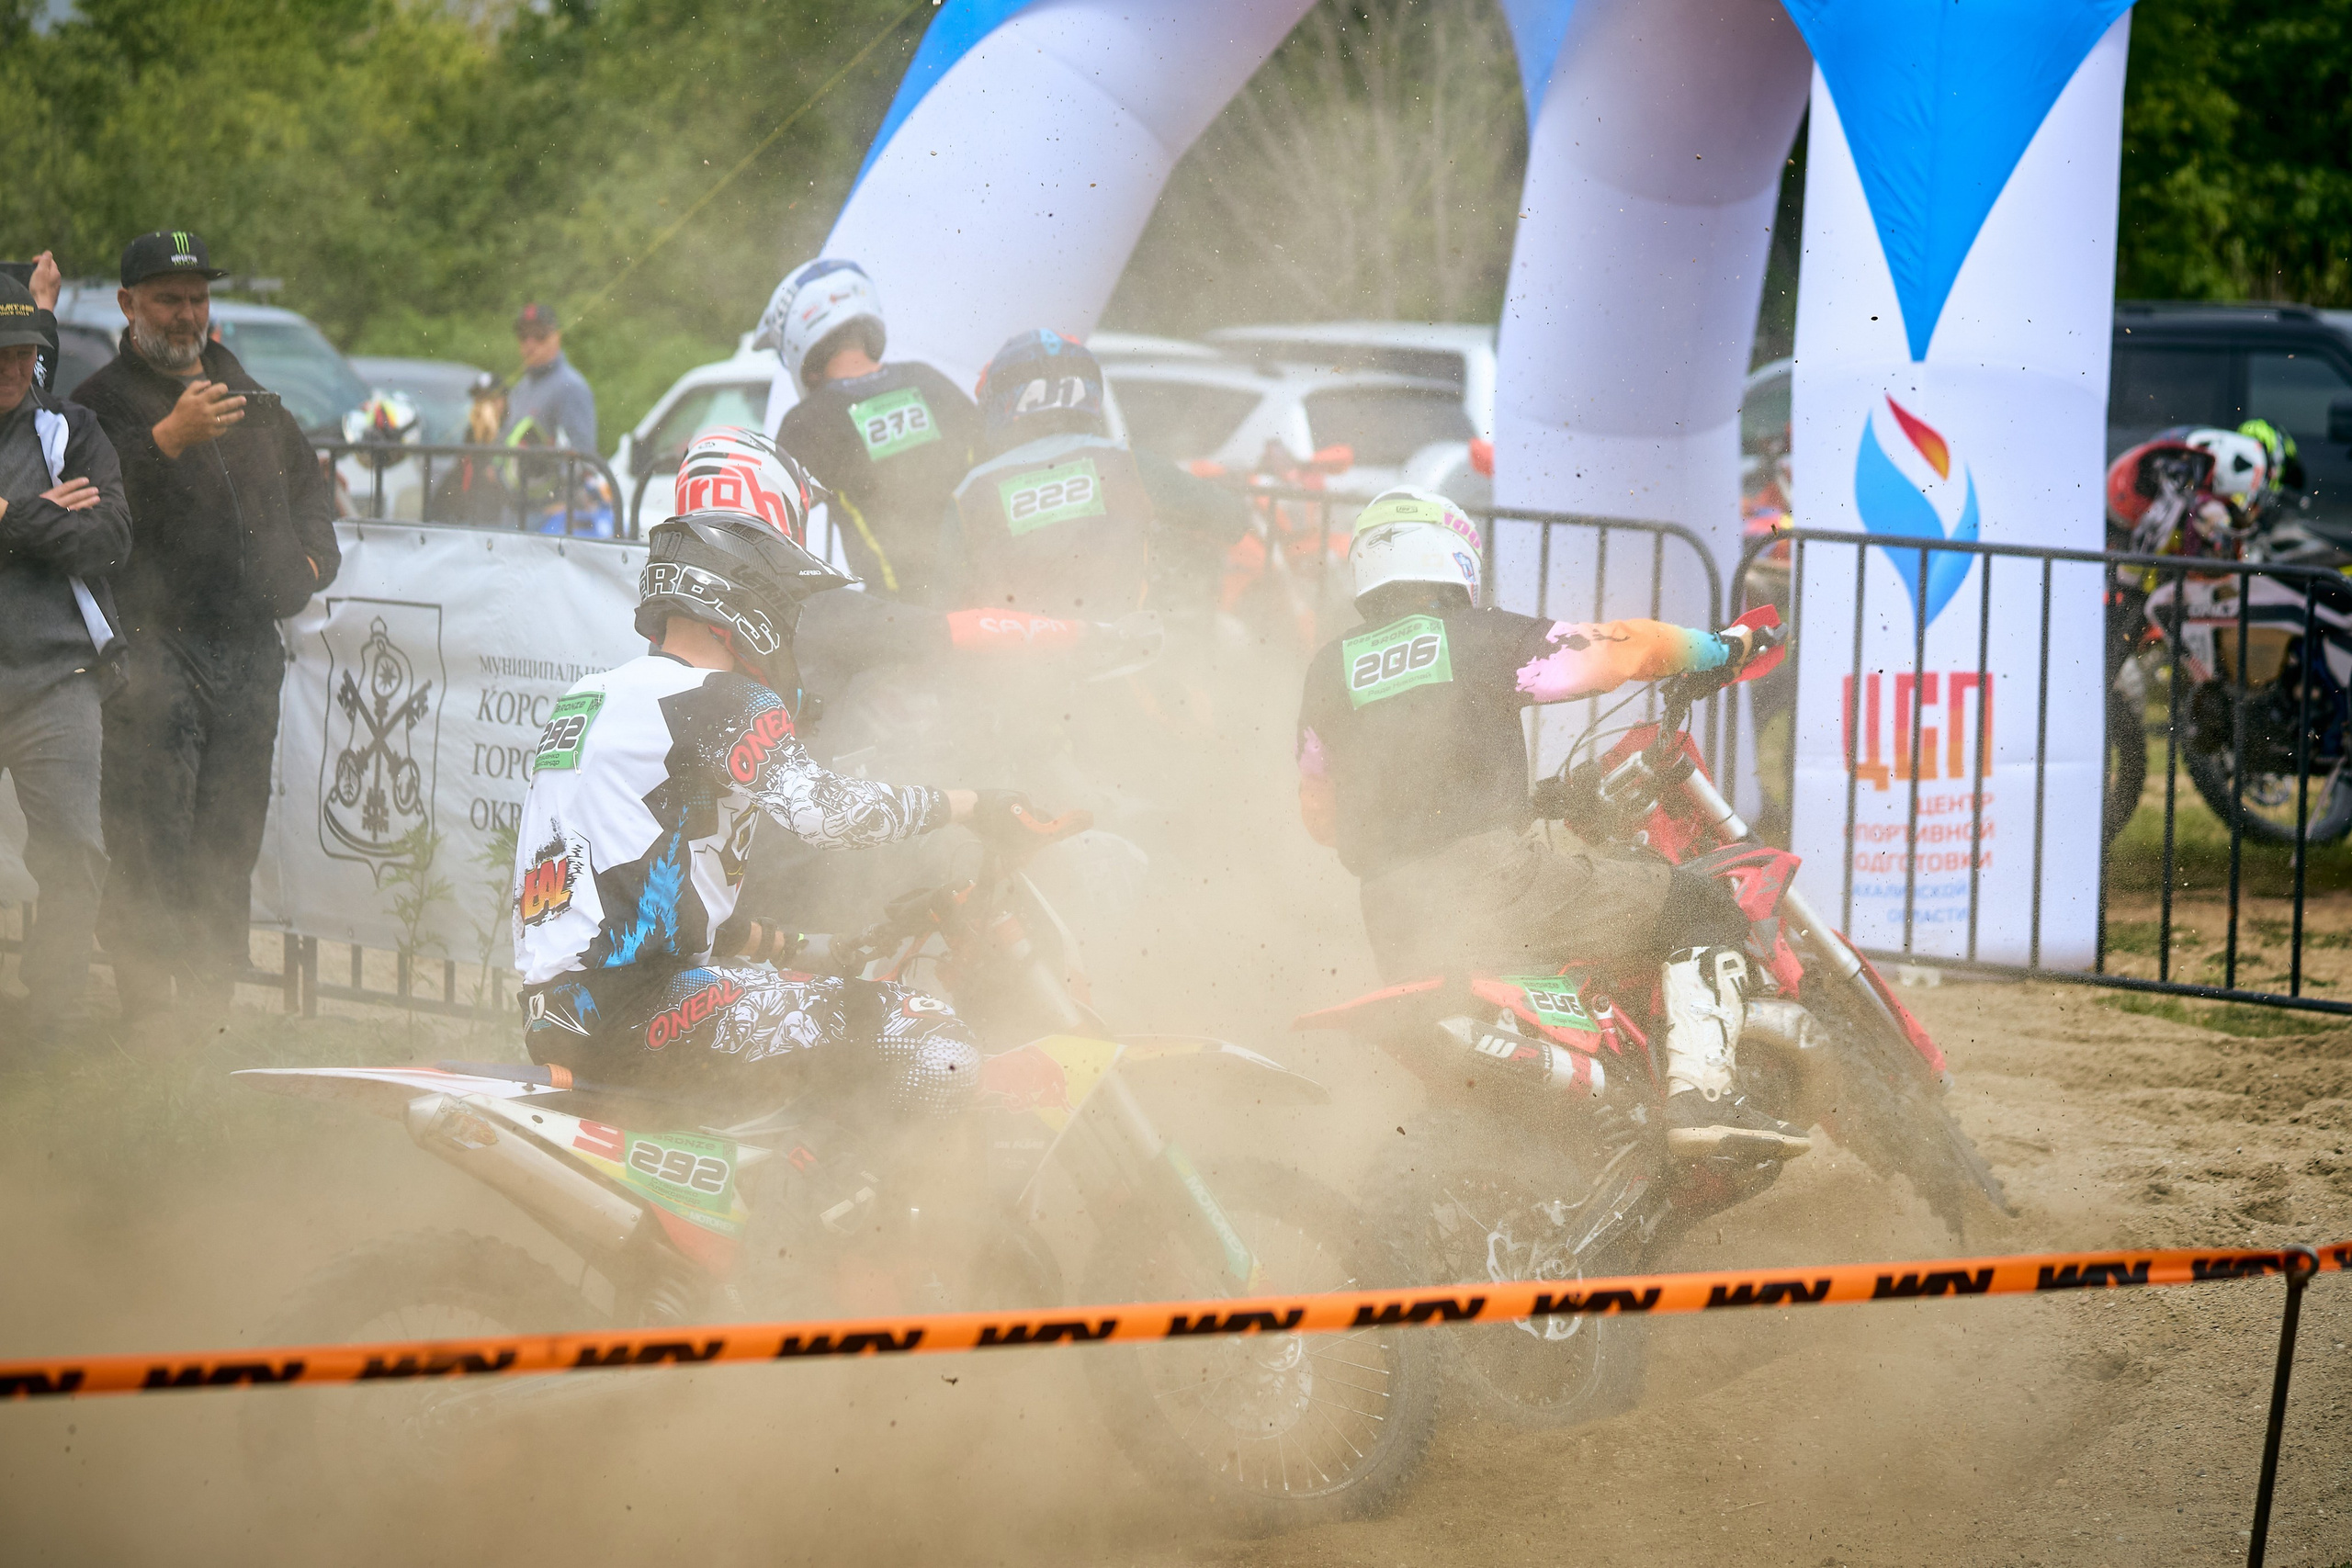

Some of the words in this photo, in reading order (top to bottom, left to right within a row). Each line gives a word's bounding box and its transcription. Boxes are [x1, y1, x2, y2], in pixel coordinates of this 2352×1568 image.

[865, 404, 929, 447] 272
[1012, 475, 1092, 521] 222
[1351, 634, 1441, 691] 206
[536, 714, 587, 758] 292
[1849, 850, 1994, 874] ОДГОТОВКИ
[647, 977, 745, 1050] ONEAL
[628, 1140, 729, 1195] 292
[689, 1211, 737, 1232] MOTOREX
